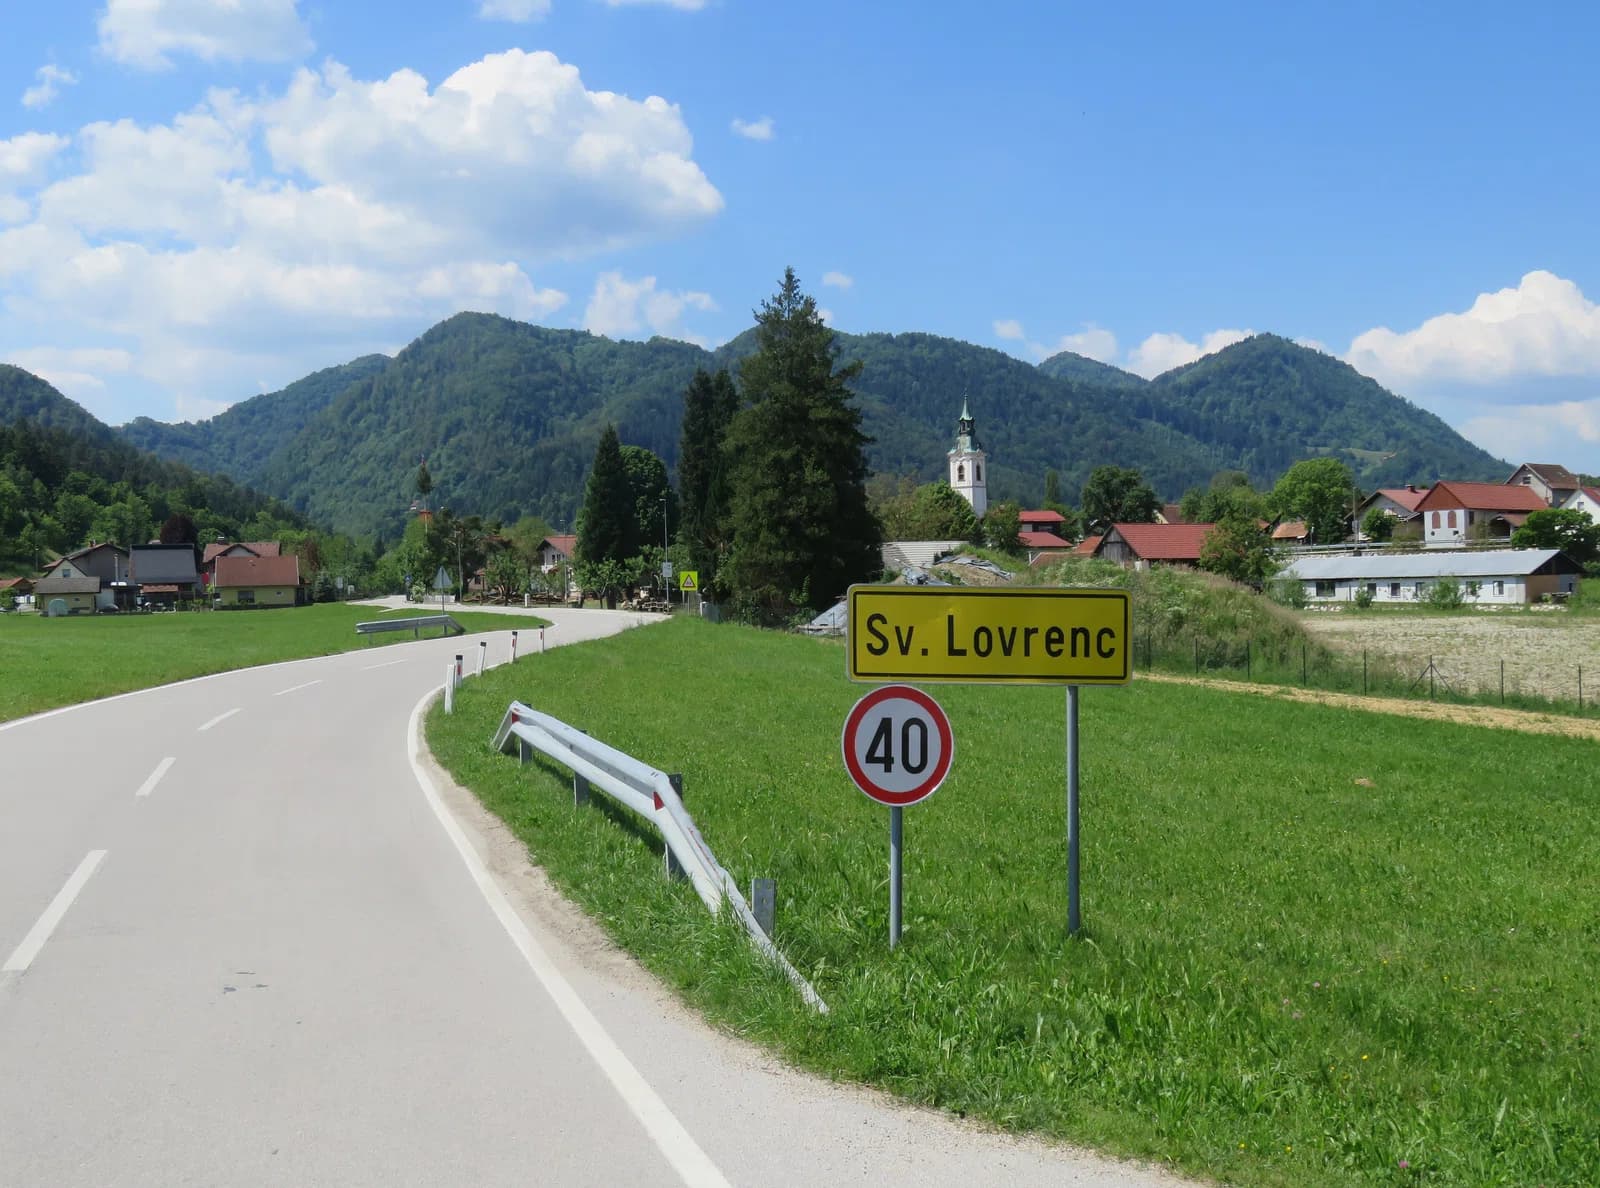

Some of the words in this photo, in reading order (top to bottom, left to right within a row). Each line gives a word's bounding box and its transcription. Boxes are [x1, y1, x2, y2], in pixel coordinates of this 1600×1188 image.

[866, 612, 929, 657] Sv.
[947, 614, 1116, 658] Lovrenc
[865, 717, 928, 775] 40
